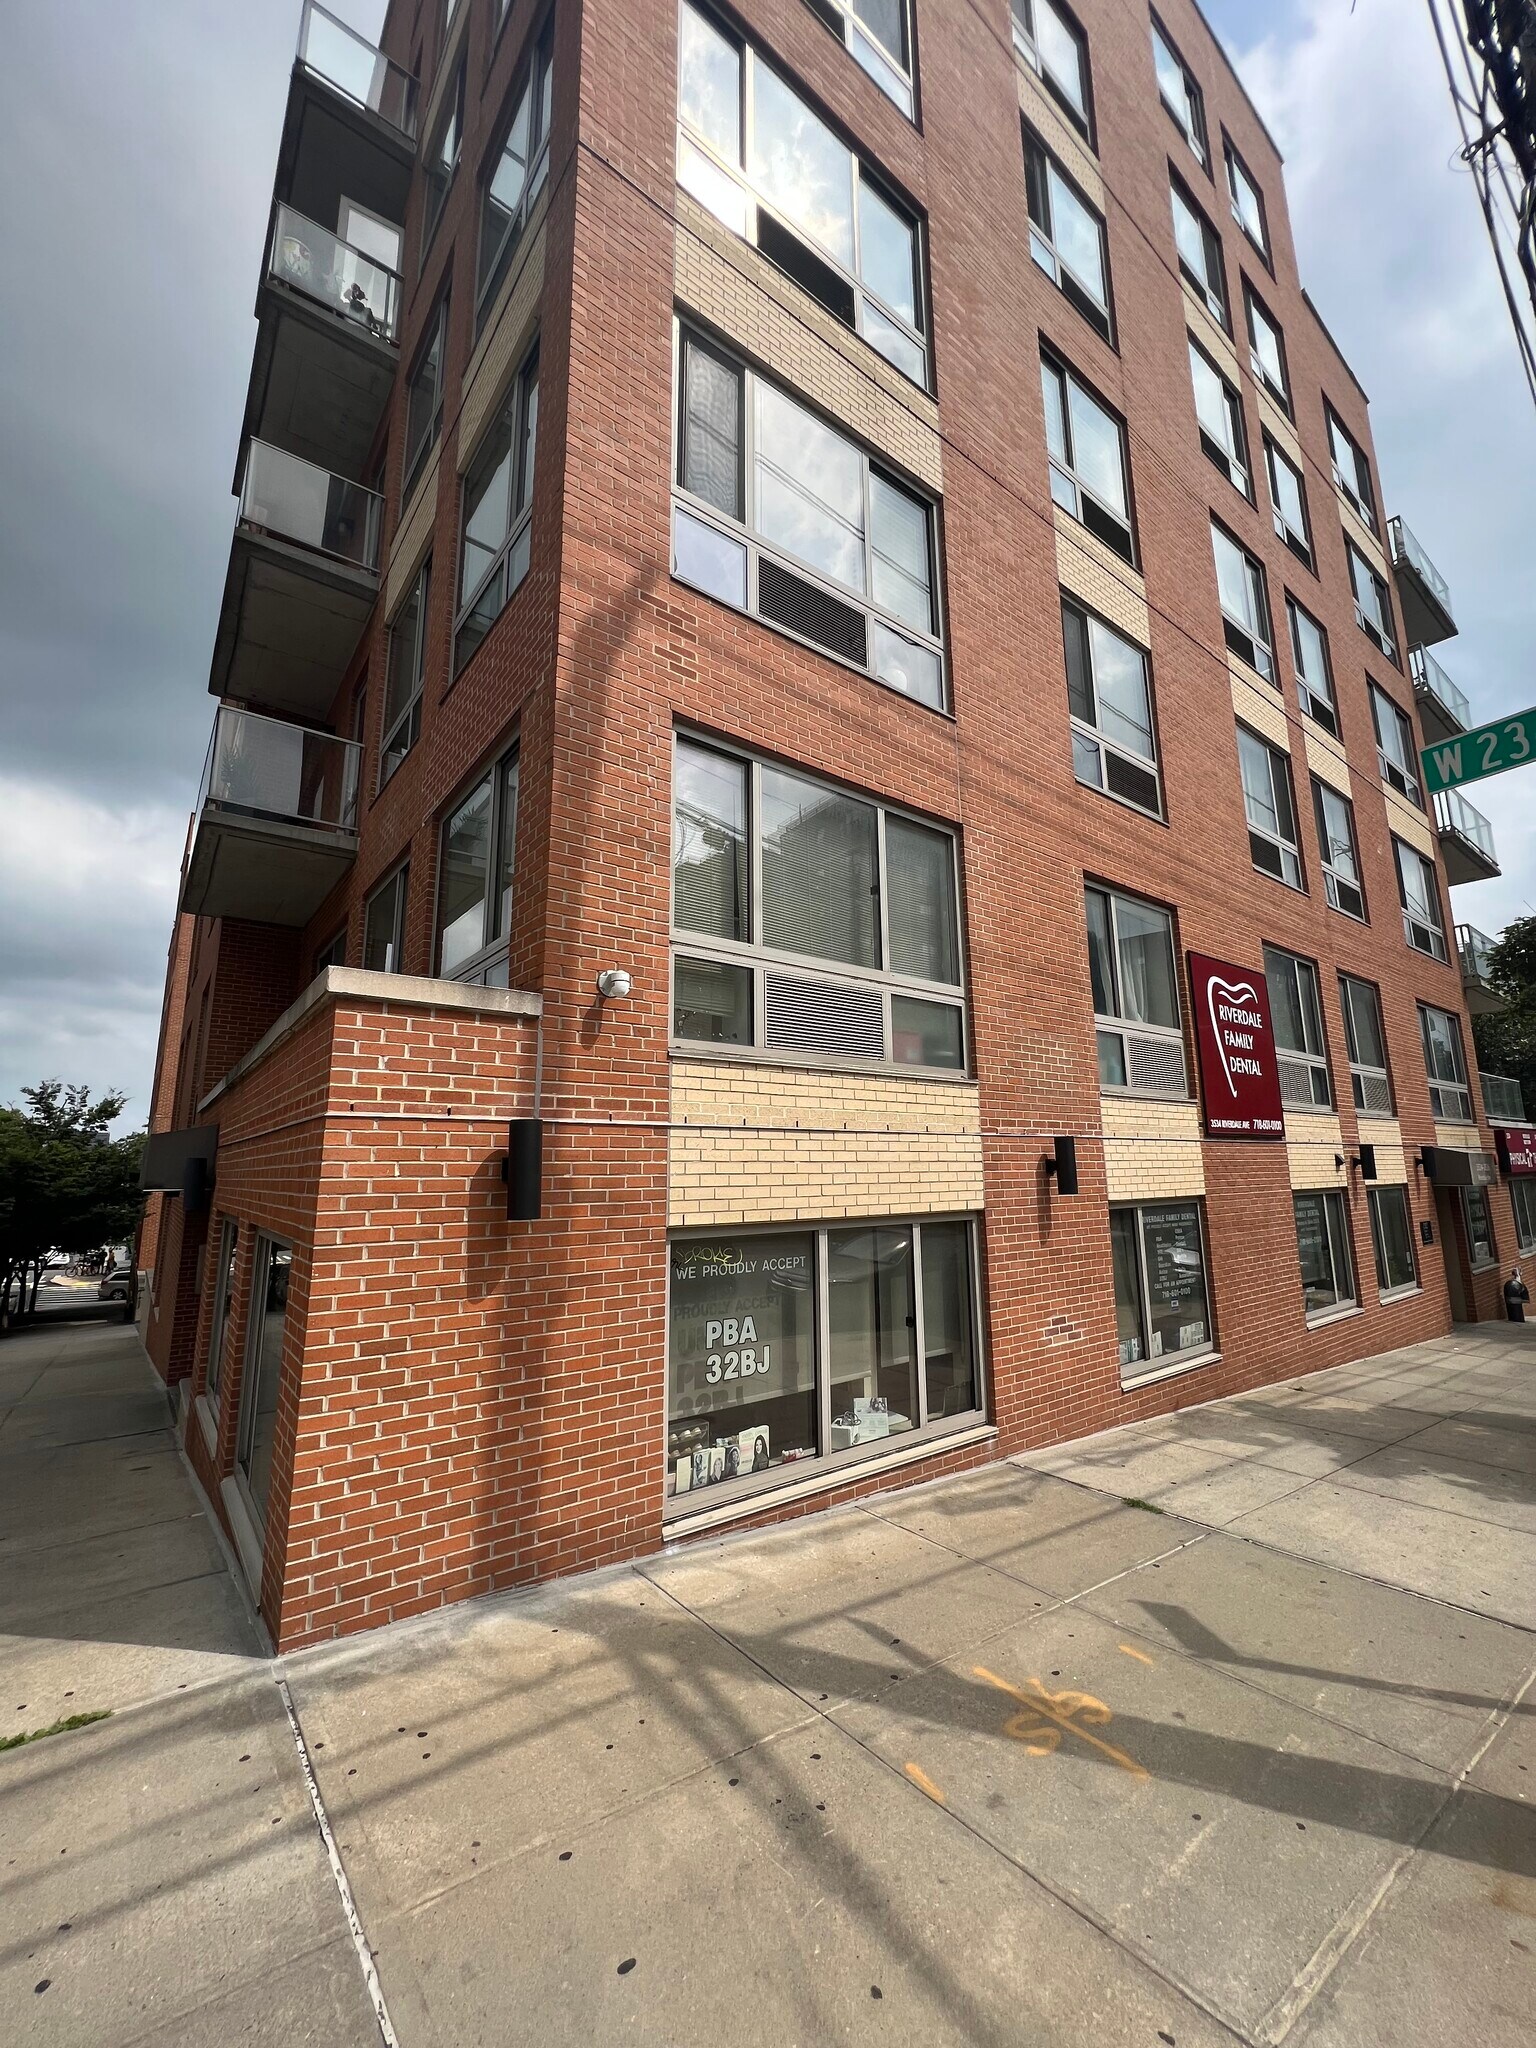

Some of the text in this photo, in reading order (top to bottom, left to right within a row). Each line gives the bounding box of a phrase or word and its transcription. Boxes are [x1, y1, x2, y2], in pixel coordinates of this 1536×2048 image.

[1432, 743, 1463, 784] W
[1218, 1004, 1263, 1029] RIVERDALE
[1224, 1029, 1254, 1050] FAMILY
[1229, 1056, 1263, 1076] DENTAL
[676, 1256, 806, 1280] WE PROUDLY ACCEPT
[705, 1315, 758, 1350] PBA
[705, 1345, 770, 1384] 32BJ
